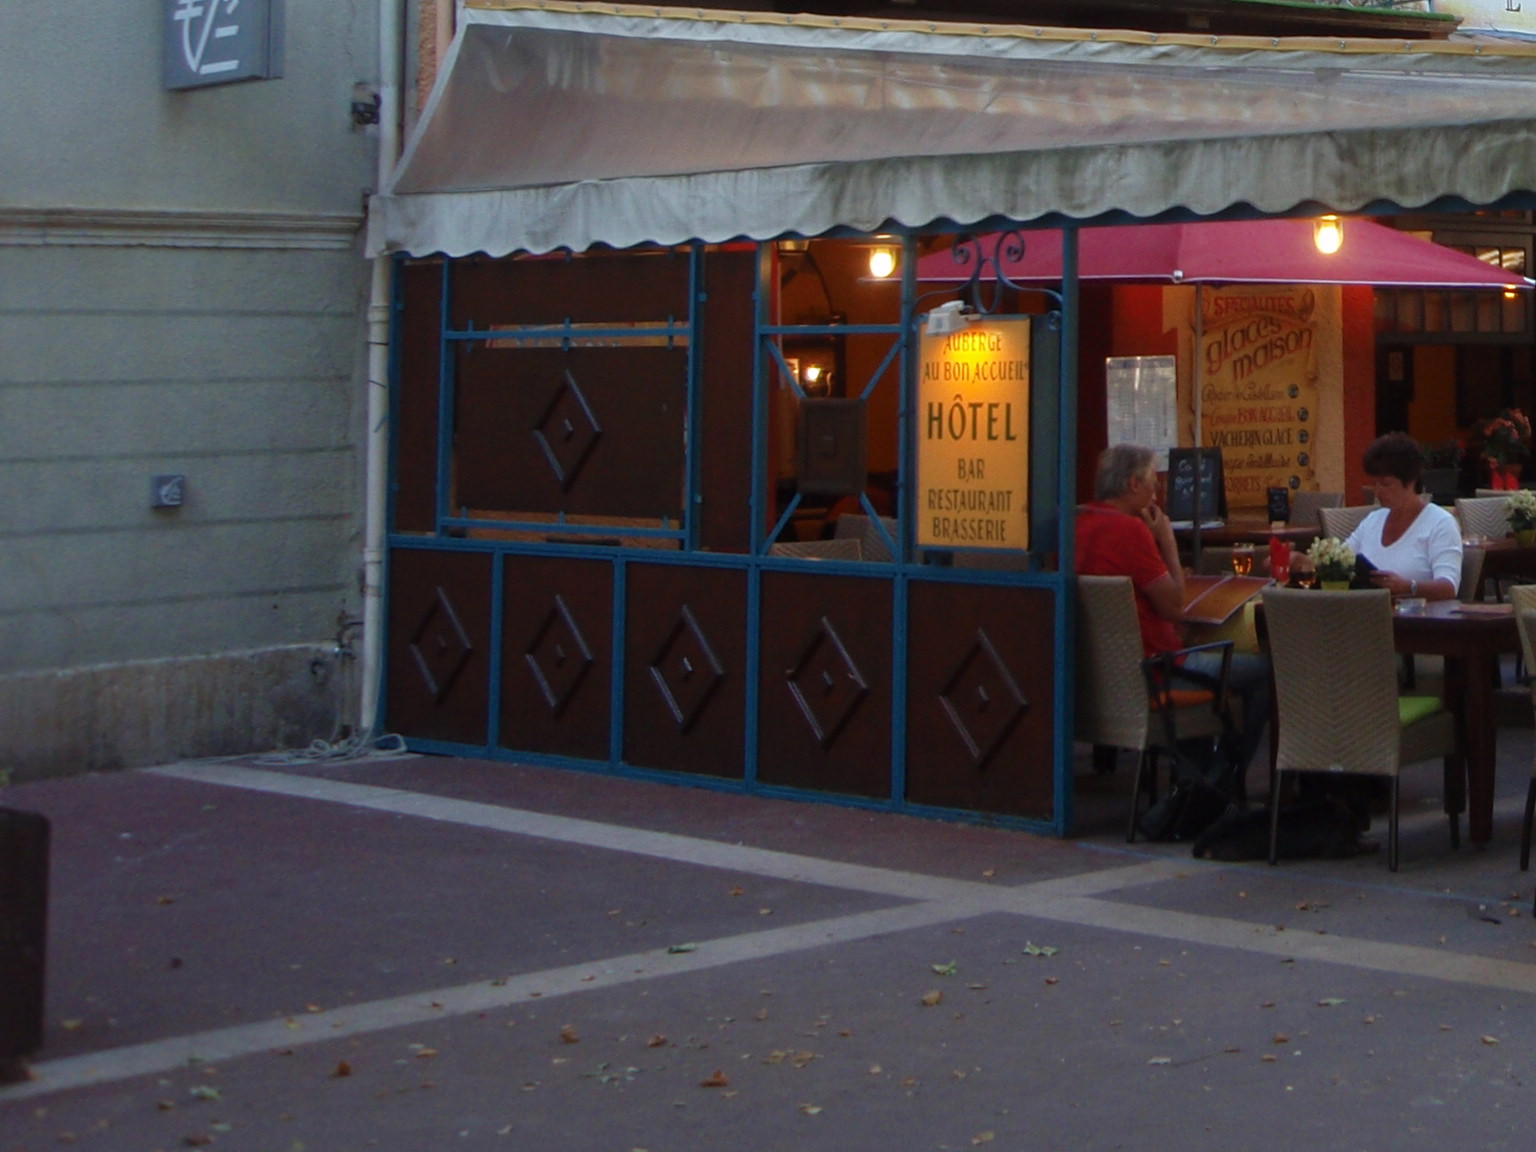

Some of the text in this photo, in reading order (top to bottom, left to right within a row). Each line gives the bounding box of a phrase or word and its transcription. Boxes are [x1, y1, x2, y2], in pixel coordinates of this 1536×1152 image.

[943, 331, 1002, 355] AUBERGE
[1206, 316, 1283, 376] glaces
[1232, 328, 1312, 381] maison
[922, 360, 1025, 384] AU BON ACCUEIL
[926, 393, 1018, 441] HÔTEL
[957, 458, 985, 482] BAR
[928, 489, 1013, 514] RESTAURANT
[932, 517, 1007, 542] BRASSERIE
